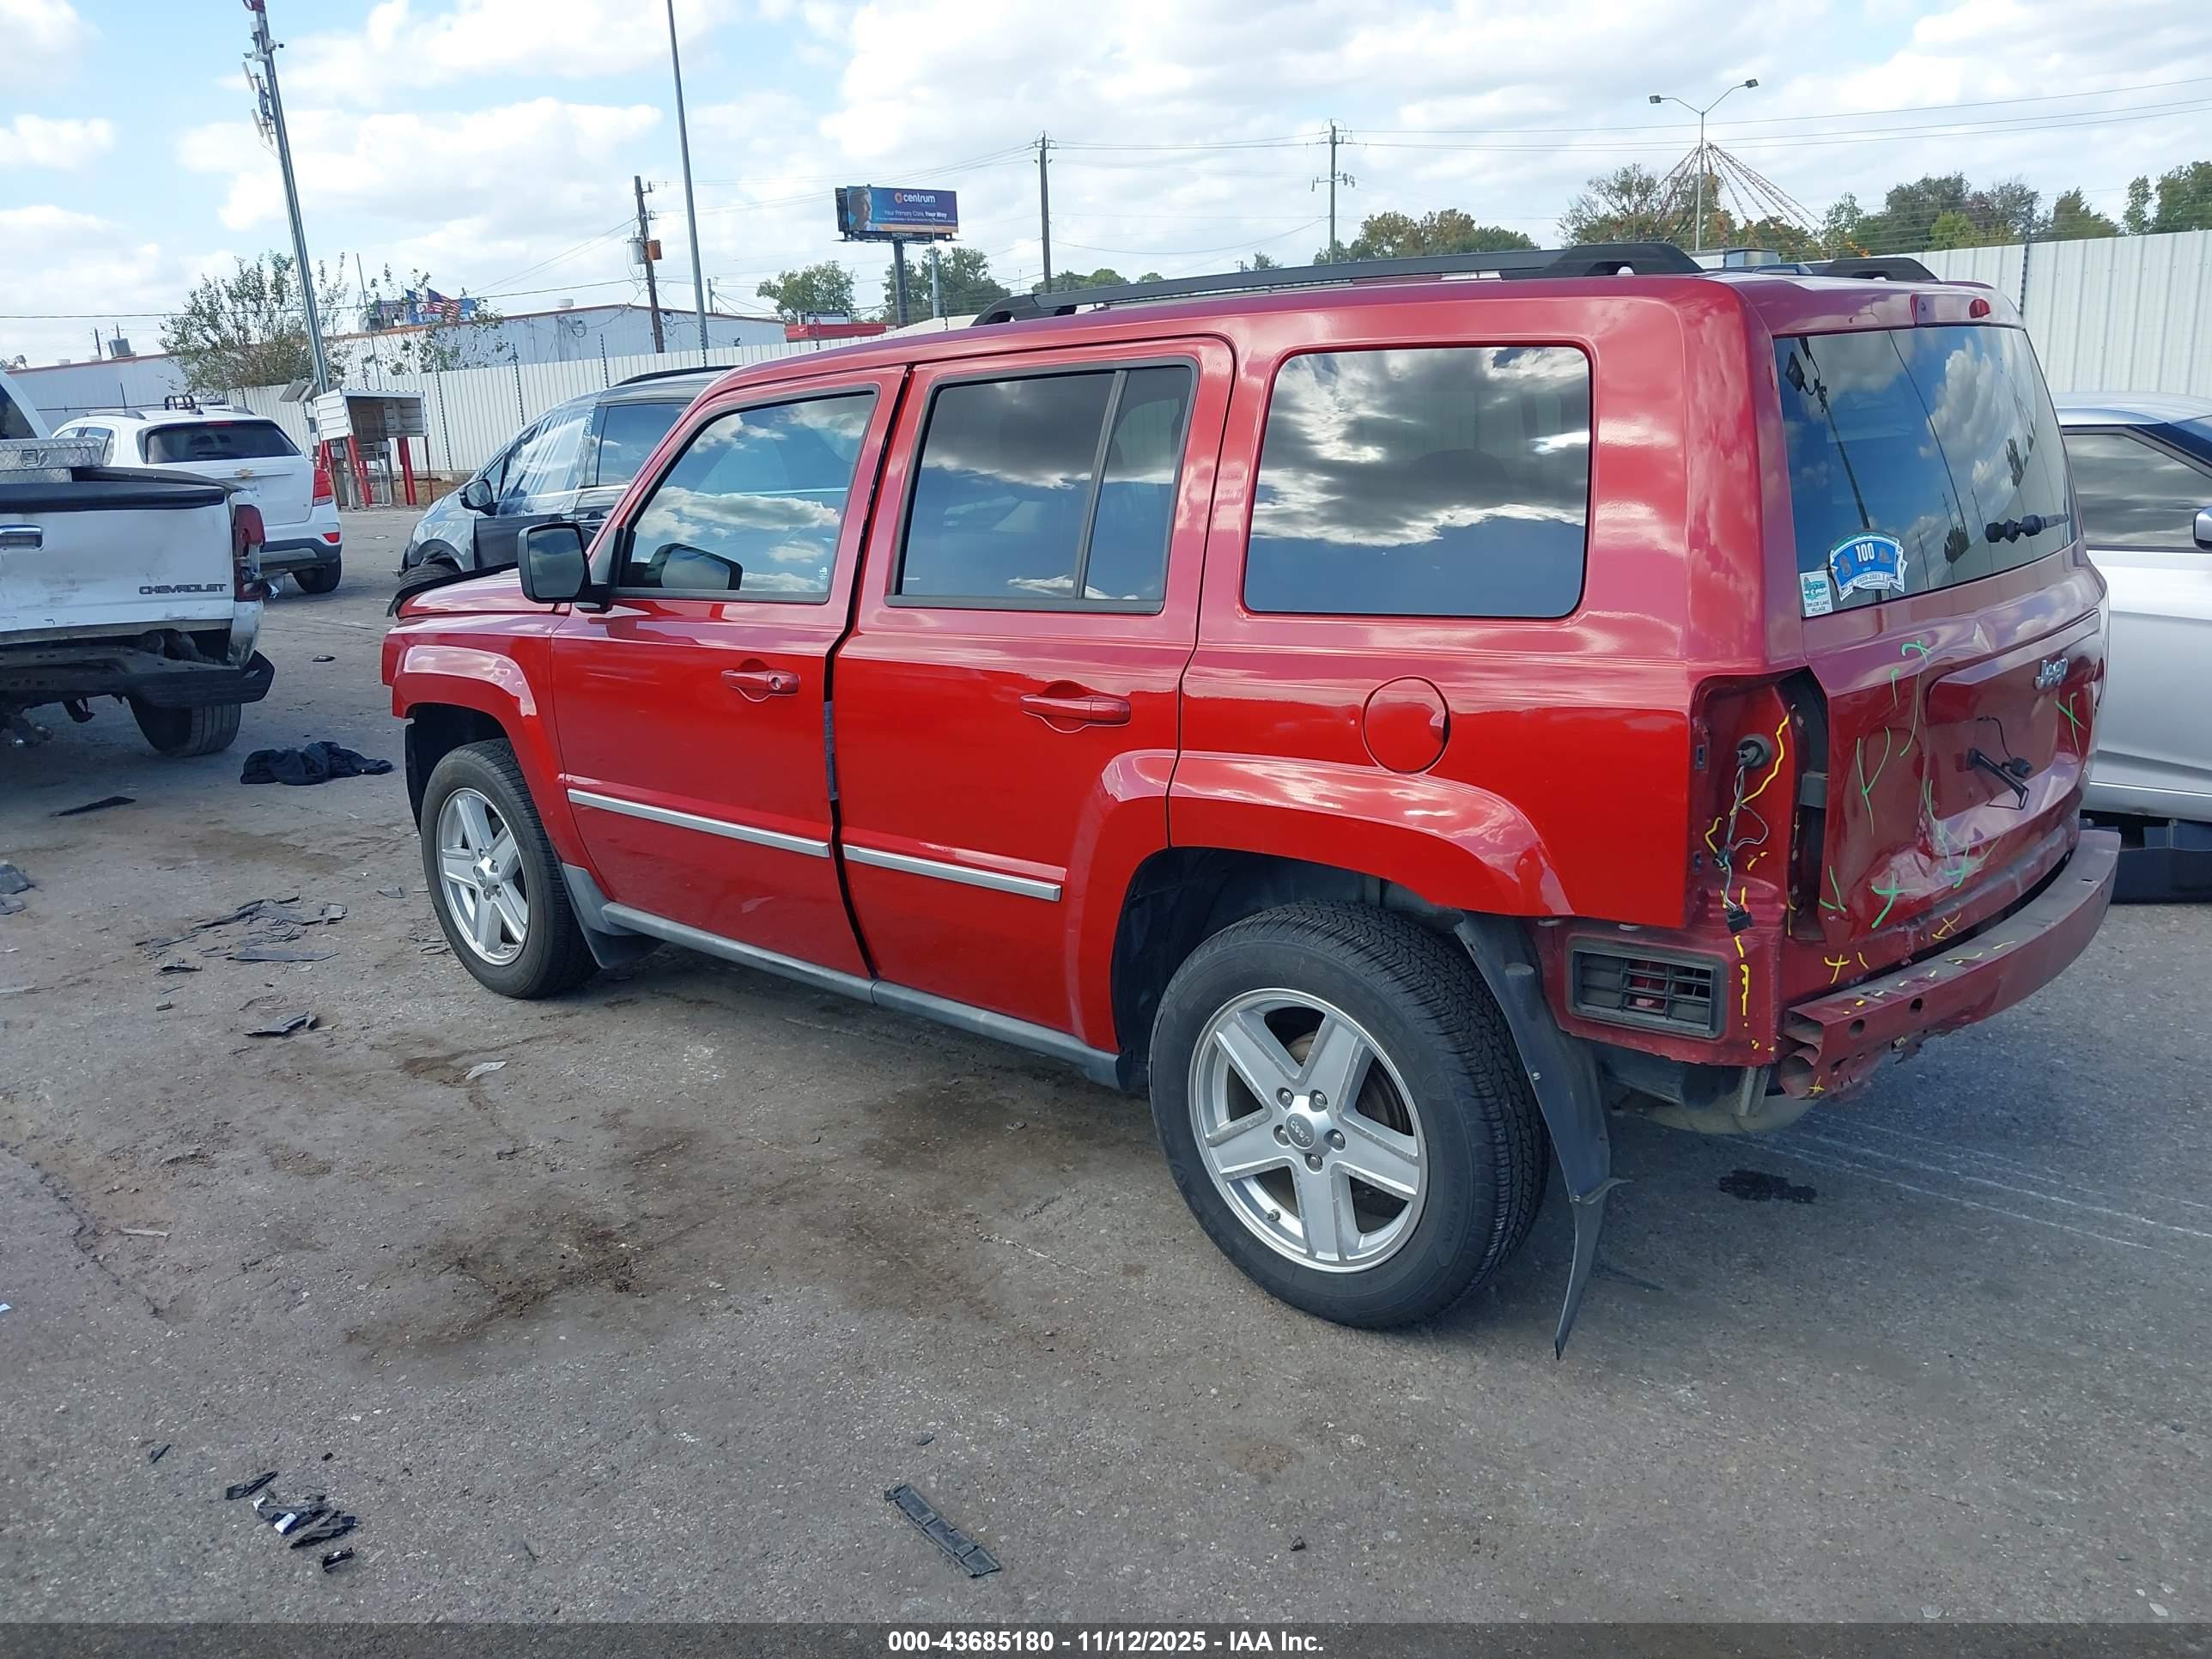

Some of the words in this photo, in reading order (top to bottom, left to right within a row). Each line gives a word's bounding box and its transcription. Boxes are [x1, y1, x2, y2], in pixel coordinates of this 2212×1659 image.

[904, 193, 935, 204] centrum
[1856, 543, 1875, 562] 100
[139, 584, 227, 595] CHEVROLET
[2035, 658, 2069, 690] Jeep
